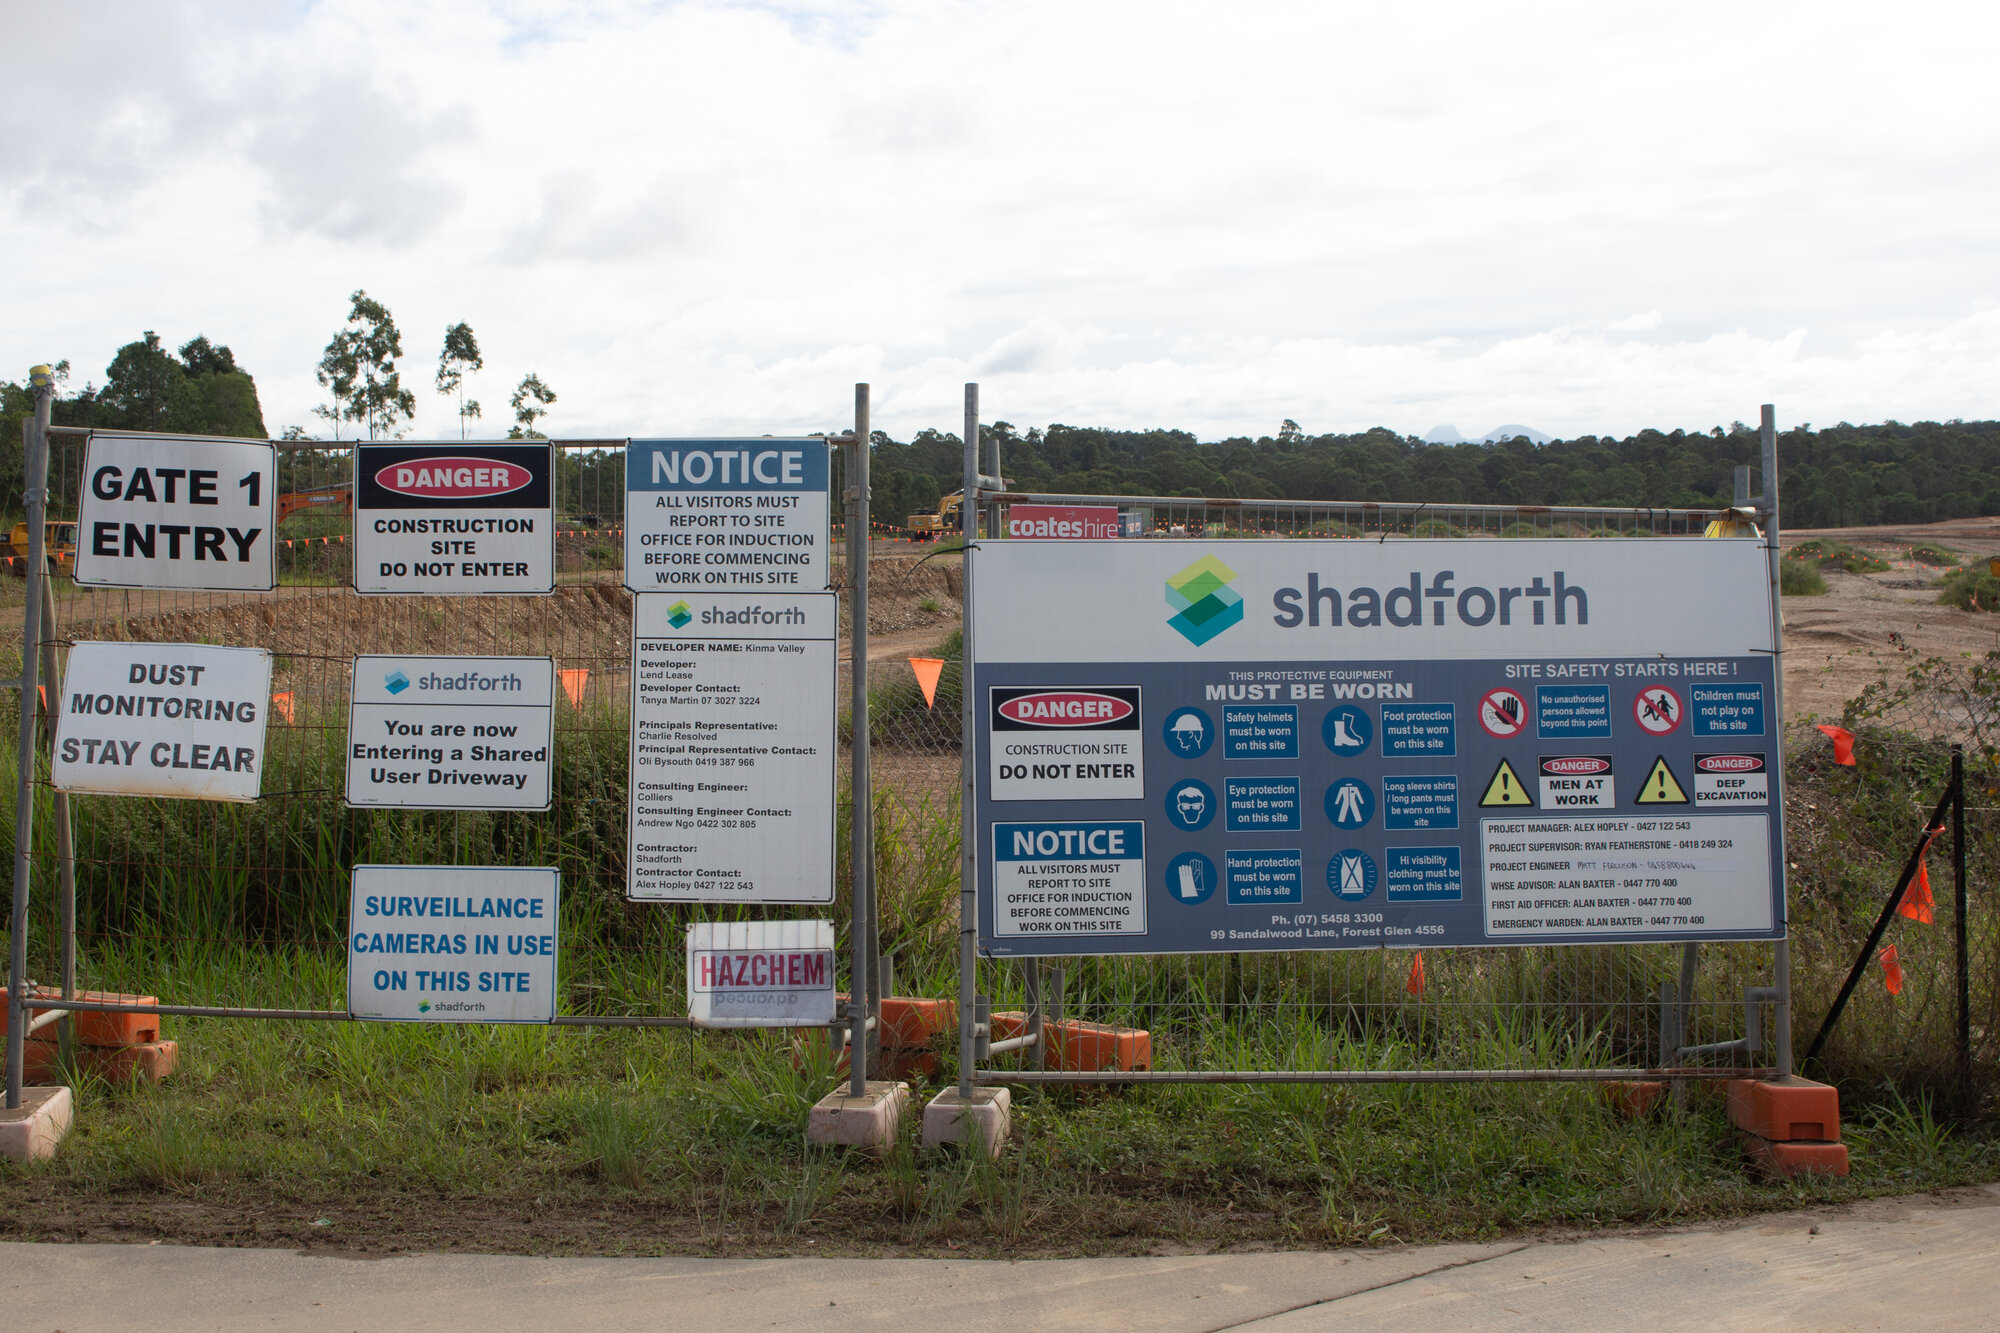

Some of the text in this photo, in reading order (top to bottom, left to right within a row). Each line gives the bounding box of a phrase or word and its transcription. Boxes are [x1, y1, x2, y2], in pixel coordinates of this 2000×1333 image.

[652, 451, 802, 483] NOTICE
[397, 468, 509, 488] DANGER
[92, 466, 260, 506] GATE 1
[656, 496, 799, 507] ALL VISITORS MUST
[374, 519, 533, 533] CONSTRUCTION
[670, 515, 784, 526] REPORT TO SITE
[93, 521, 261, 562] ENTRY
[640, 534, 813, 545] OFFICE FOR INDUCTION
[431, 541, 475, 554] SITE
[645, 553, 809, 564] BEFORE COMMENCING
[380, 562, 528, 576] DO NOT ENTER
[655, 572, 798, 583] WORK ON THIS SITE
[1273, 570, 1587, 628] shadforth
[701, 605, 804, 624] shadforth
[641, 643, 704, 651] DEVELOPER
[746, 644, 774, 652] Kinma
[778, 644, 804, 654] Valley
[641, 660, 695, 669] Developer:
[1505, 662, 1736, 677] SITE SAFETY STARTS HERE !
[129, 663, 204, 686] DUST
[666, 671, 692, 679] Lease
[1229, 670, 1393, 680] THIS PROTECTIVE EQUIPMENT
[419, 672, 521, 691] shadforth
[640, 684, 739, 693] Developer Contact:
[1206, 683, 1412, 700] MUST BE WORN
[640, 696, 667, 705] Tanya
[670, 696, 698, 704] Martin
[701, 696, 712, 704] 07
[715, 696, 736, 704] 3027
[71, 693, 255, 722] MONITORING
[1018, 702, 1113, 718] DANGER
[1226, 712, 1293, 724] Safety helmets
[384, 720, 517, 737] You are now
[639, 721, 777, 731] Principals Representative:
[1229, 727, 1252, 736] must
[1255, 726, 1265, 735] be
[639, 731, 717, 740] Charlie Resolved
[639, 745, 816, 755] Principal Representative Contact:
[1005, 744, 1127, 755] CONSTRUCTION SITE
[1235, 740, 1285, 750] on this site
[61, 738, 255, 773] STAY CLEAR
[353, 744, 546, 764] Entering a Shared
[639, 757, 754, 767] Oli Bysouth 0419 387 966
[1552, 761, 1600, 771] DANGER
[1707, 759, 1753, 769] DANGER
[999, 764, 1134, 779] DO NOT ENTER
[371, 768, 527, 789] User Driveway
[1549, 779, 1603, 789] MEN AT
[1717, 779, 1745, 787] DEEP
[638, 782, 747, 792] Consulting Engineer:
[638, 793, 672, 801] Colliers
[1555, 795, 1598, 805] WORK
[1696, 791, 1766, 800] EXCAVATION
[637, 806, 791, 817] Consulting Engineer Contact:
[637, 819, 756, 829] Andrew Ngo 0422 302 805
[1488, 824, 1525, 833] PROJECT
[1528, 823, 1571, 832] MANAGER:
[1574, 823, 1594, 831] ALEX
[1597, 822, 1628, 831] HOPLEY
[1637, 822, 1656, 830] 0427
[1659, 822, 1673, 830] 122
[1675, 821, 1690, 830] 543
[637, 843, 696, 852] Contractor:
[1014, 830, 1124, 855] NOTICE
[636, 854, 681, 863] Shadforth
[636, 867, 741, 877] Contractor Contact:
[636, 880, 753, 890] Alex Hopley 0427 122 543
[365, 896, 543, 918] SURVEILLANCE
[1272, 913, 1382, 926] Ph. (07) 5458 3300
[1210, 925, 1444, 939] 99 Sandalwood Lane, Forest Glen 4556
[354, 933, 553, 955] CAMERAS IN USE
[702, 954, 824, 987] HAZCHEM
[374, 970, 529, 992] ON THIS SITE
[435, 1002, 485, 1011] shadforth
